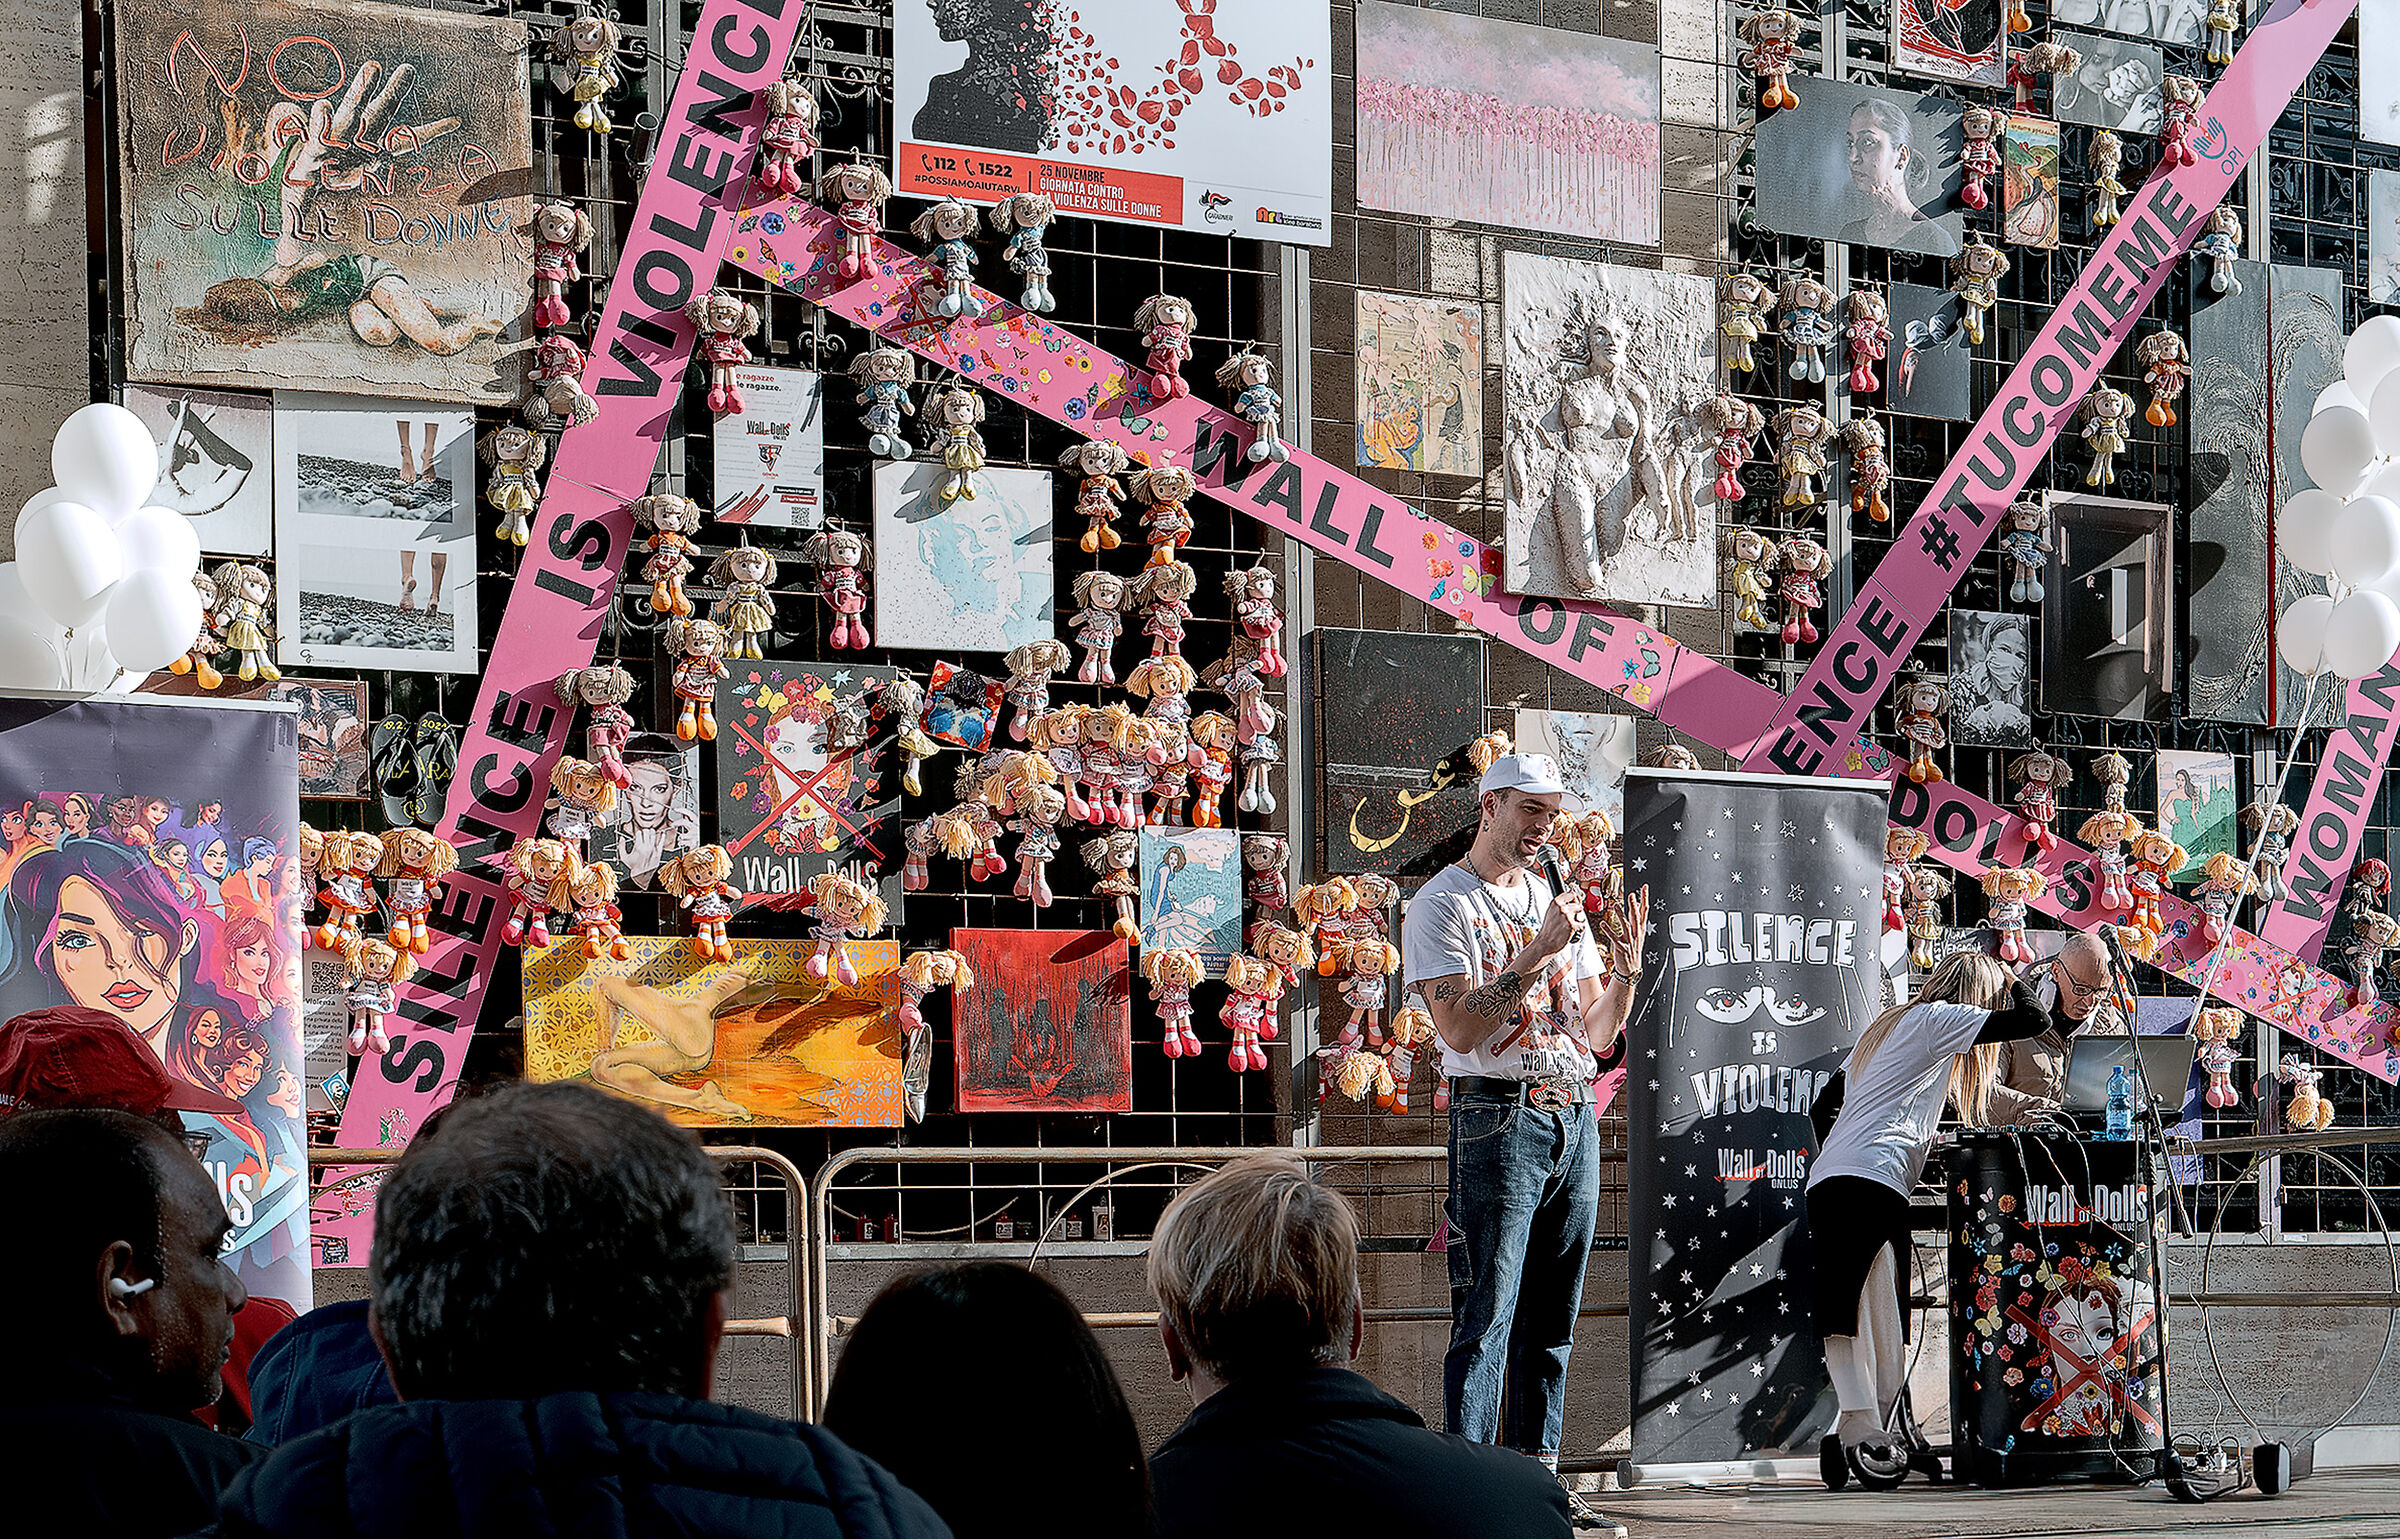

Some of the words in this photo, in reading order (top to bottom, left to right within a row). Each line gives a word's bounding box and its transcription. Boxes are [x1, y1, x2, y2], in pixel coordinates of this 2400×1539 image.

[164, 22, 347, 100] NO
[273, 112, 421, 155] ALLA
[163, 122, 499, 199] VIOLENZA
[934, 156, 956, 172] 112
[978, 161, 1013, 178] 1522
[1040, 164, 1053, 178] 25
[1055, 167, 1105, 184] NOVEMBRE
[2221, 146, 2244, 176] OPI
[914, 174, 1020, 194] #POSSIAMOAIUTARVI
[1040, 177, 1085, 195] GIORNATA
[1087, 182, 1124, 200] CONTRO
[163, 183, 349, 243] SULLE
[366, 197, 513, 249] DONNE
[1053, 192, 1099, 211] VIOLENZA
[1100, 198, 1129, 214] SULLE
[1131, 202, 1162, 218] DONNE
[743, 374, 775, 383] ragazze
[746, 383, 782, 392] ragazze.
[1920, 179, 2197, 573] #TUCOMEME
[746, 420, 764, 434] Wall
[380, 690, 559, 1094] SILENCE
[533, 513, 611, 607] IS
[595, 0, 787, 397] VIOLENC
[1194, 418, 1395, 570] WALL
[1518, 595, 1615, 663] OF
[742, 856, 800, 894] Wall
[1668, 910, 1858, 972] SILENCE
[1752, 1031, 1777, 1056] IS
[1520, 1051, 1547, 1071] Wall
[1717, 1148, 1754, 1178] Wall
[1766, 1149, 1806, 1179] Dolls
[1771, 1179, 1799, 1190] ONLUS
[2025, 1184, 2075, 1223] Wall
[2094, 1184, 2148, 1223] Dolls
[2112, 1222, 2136, 1232] ONLUS
